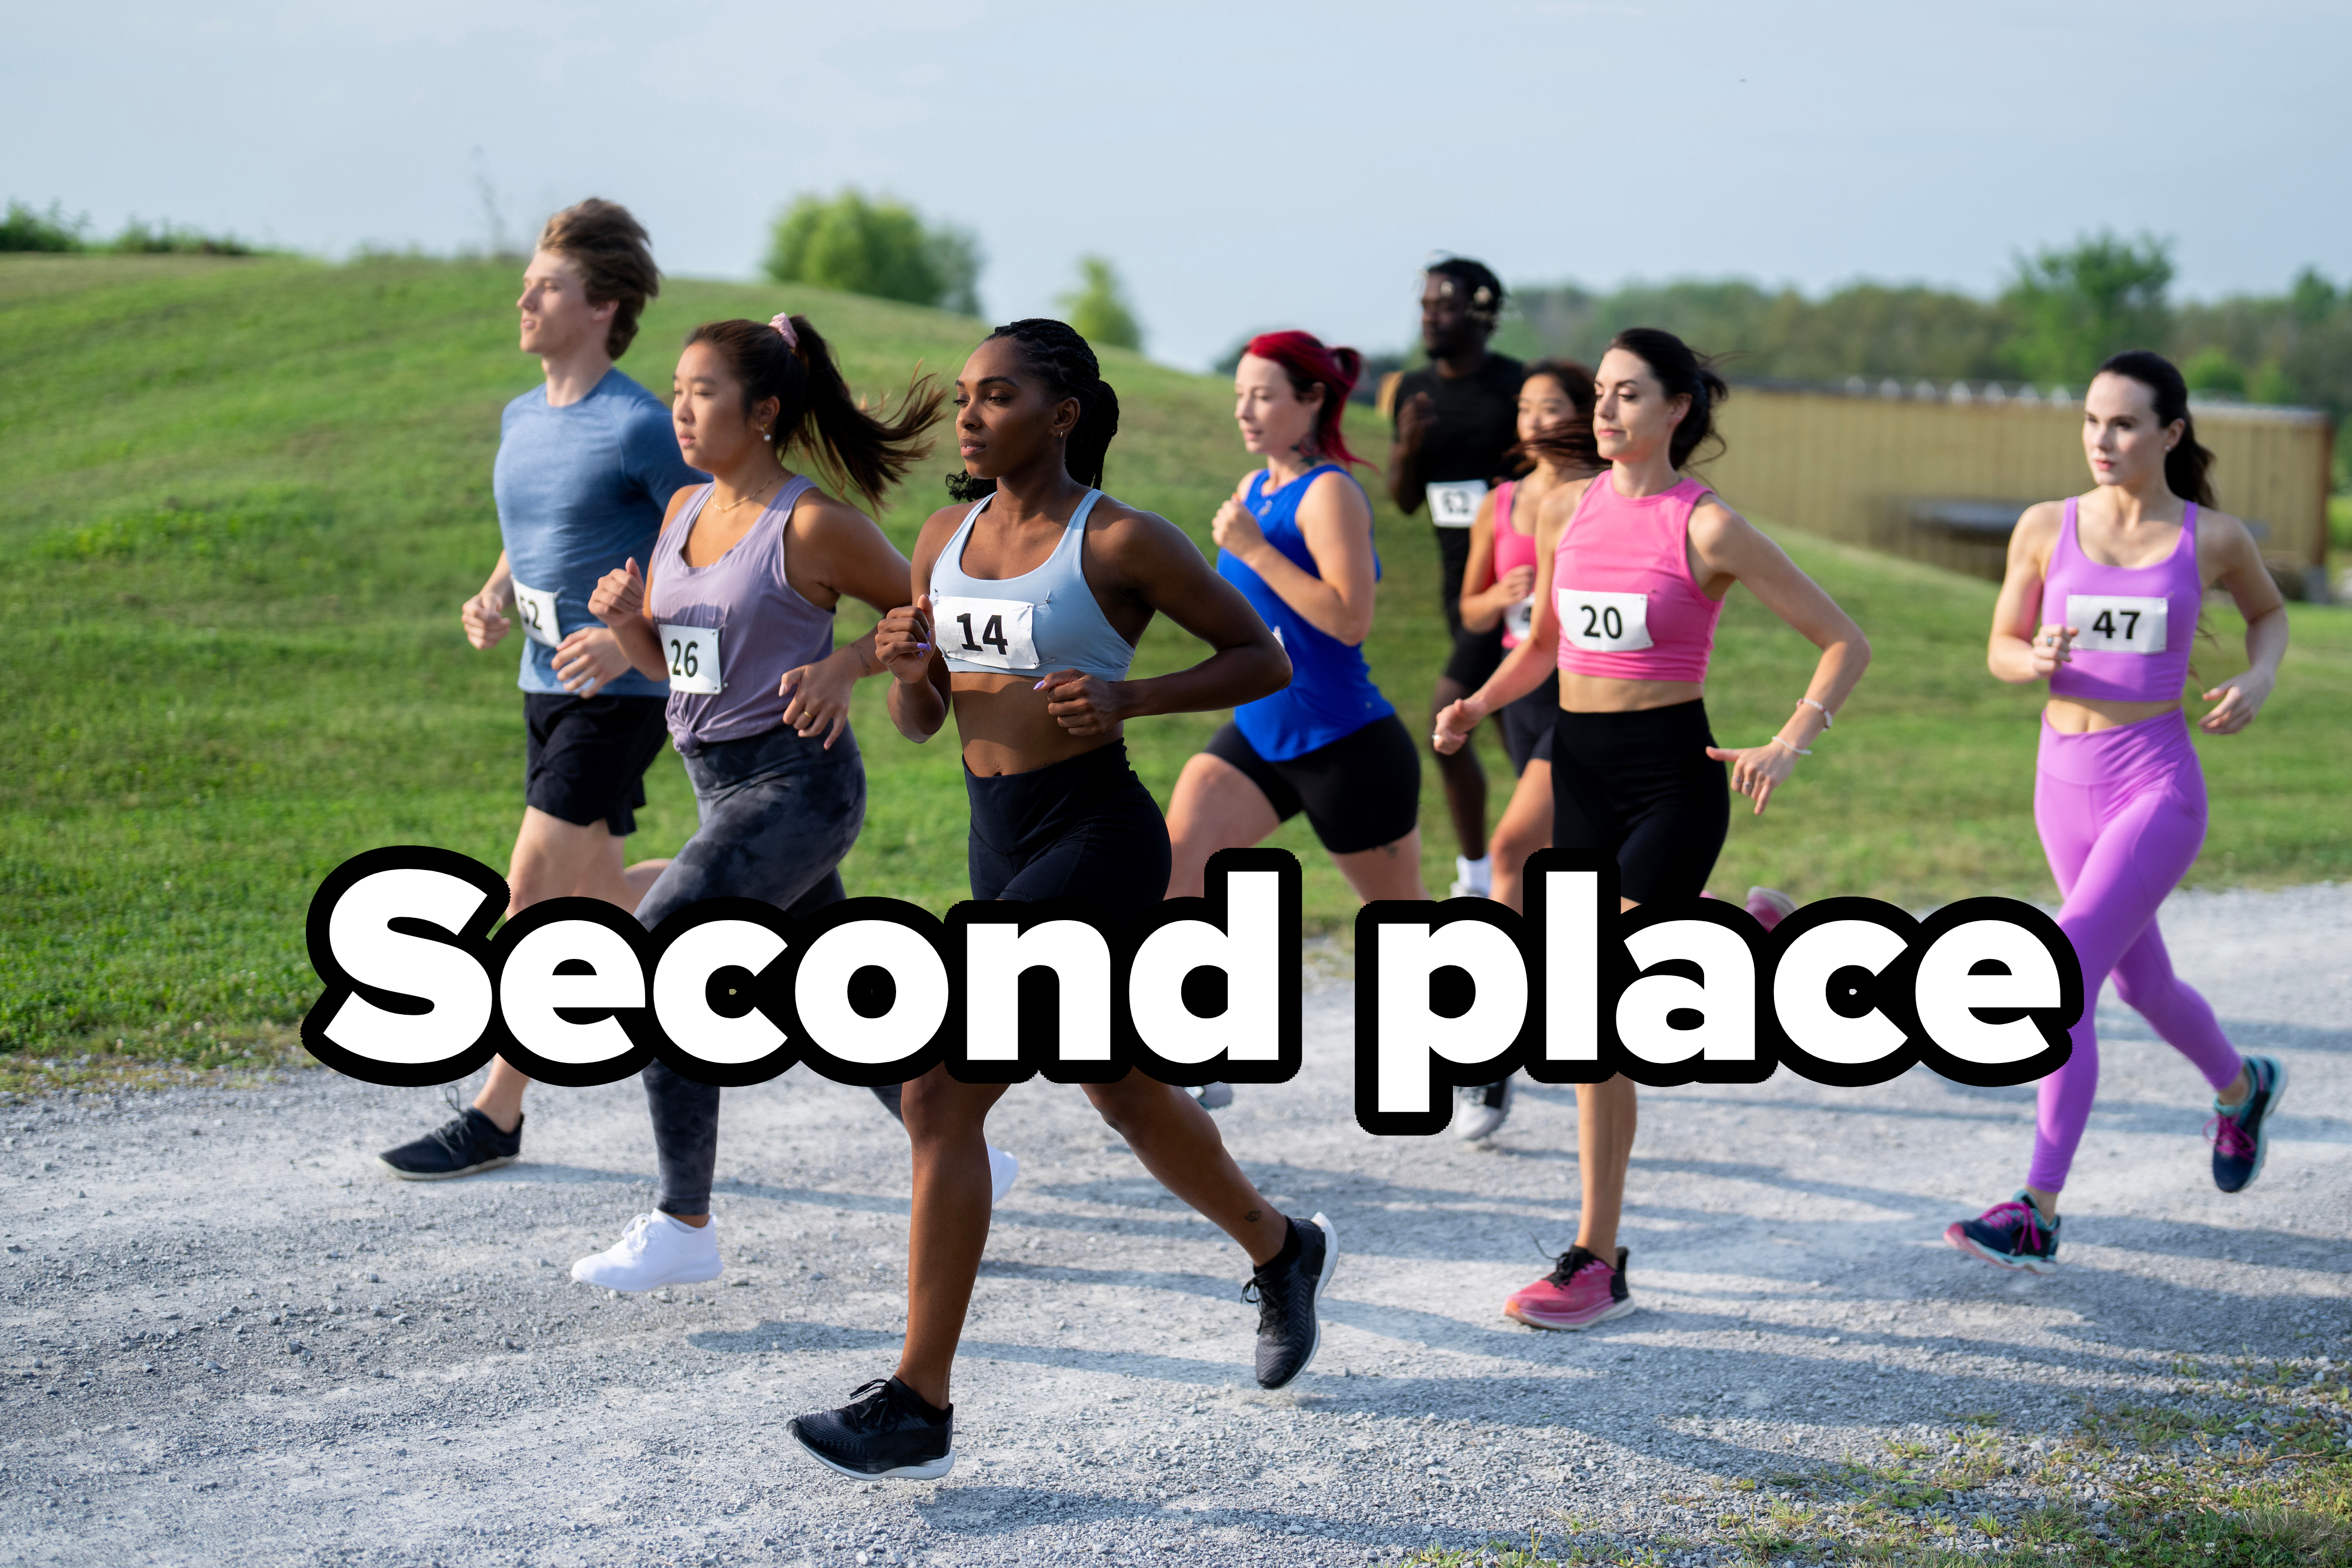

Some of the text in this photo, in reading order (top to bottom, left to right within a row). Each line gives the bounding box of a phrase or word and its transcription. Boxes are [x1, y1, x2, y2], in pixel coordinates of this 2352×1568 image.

[956, 613, 1009, 656] 14
[1580, 605, 1623, 640] 20
[2092, 609, 2141, 640] 47
[670, 638, 699, 678] 26
